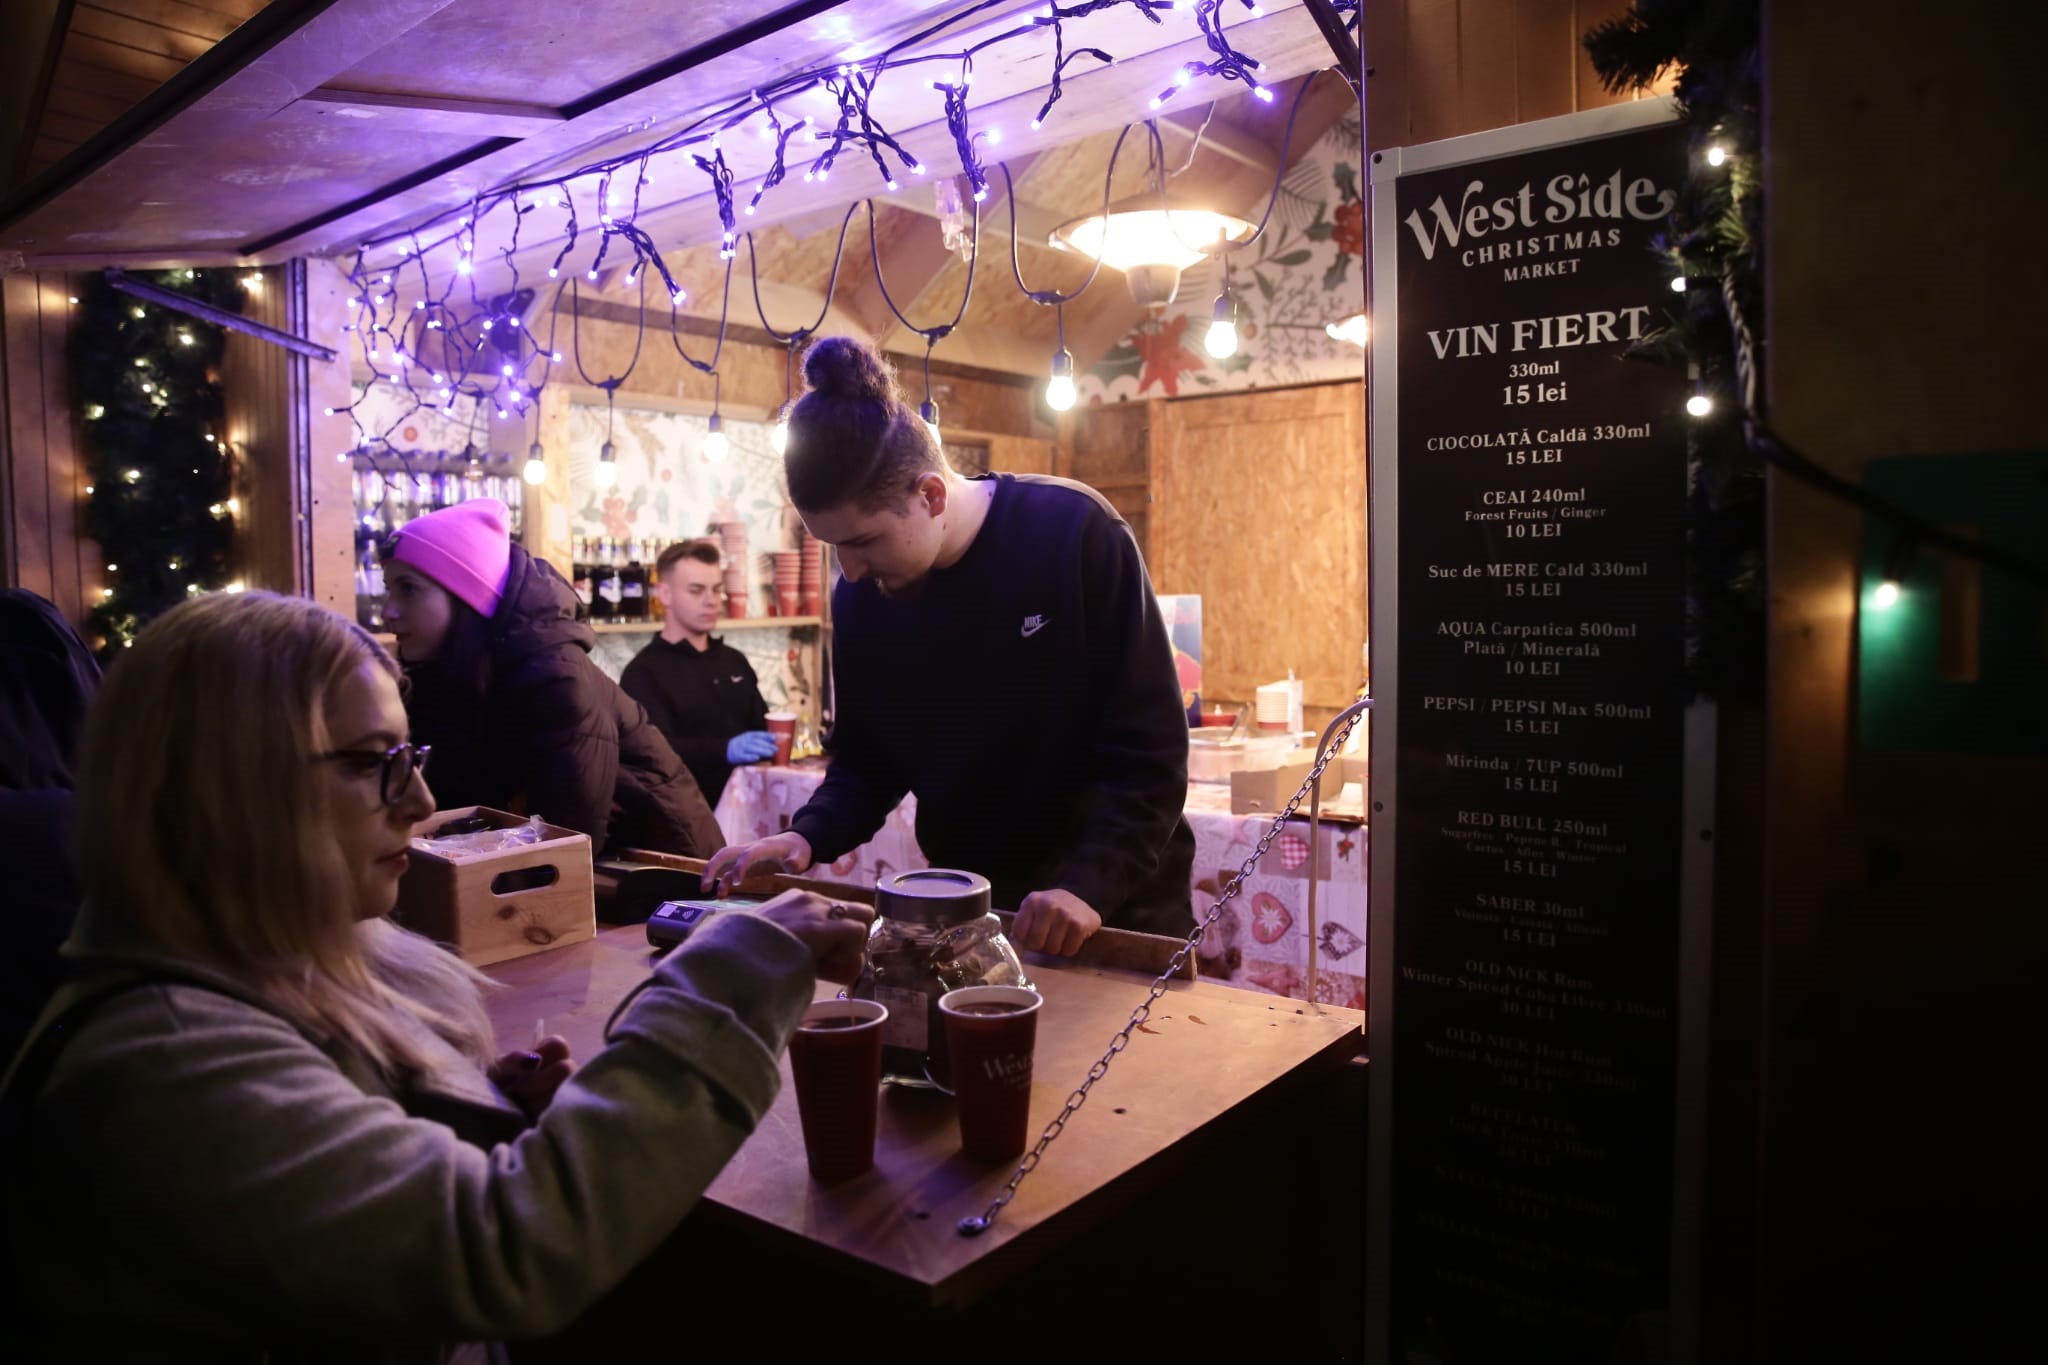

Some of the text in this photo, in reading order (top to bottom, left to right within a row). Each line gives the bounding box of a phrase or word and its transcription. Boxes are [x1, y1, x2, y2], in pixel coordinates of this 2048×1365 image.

[1405, 180, 1539, 261] West
[1462, 229, 1621, 267] CHRISTMAS
[1504, 258, 1581, 282] MARKET
[1427, 306, 1650, 360] VIN FIERT
[1509, 361, 1560, 377] 330ml
[1503, 382, 1567, 405] 15 lei
[1427, 423, 1651, 451] CIOCOLATĂ Caldă 330ml
[1506, 449, 1563, 466] 15 LEI
[1483, 488, 1585, 505] CEAI 240ml
[1465, 510, 1504, 520] Forest
[1509, 509, 1548, 520] Fruits
[1560, 507, 1606, 520] Ginger
[1505, 524, 1561, 538] 10 LEI
[1428, 562, 1648, 578] Suc de MERE Cald 330ml
[1506, 583, 1560, 596] 15 LEI
[1024, 614, 1042, 628] NIKE
[1437, 621, 1637, 639] AQUA Carpatica 500ml
[1464, 640, 1504, 655] Plată
[1522, 641, 1600, 657] Minerală
[1504, 661, 1560, 676] 10 LEI
[1424, 697, 1475, 711] PEPSI
[1491, 698, 1546, 714] PEPSI
[1552, 701, 1588, 716] Max
[1594, 704, 1652, 719] 500ml
[1504, 719, 1560, 734] 15 LEI
[1445, 754, 1509, 771] Mirinda
[1526, 759, 1561, 774] 7UP
[1568, 761, 1623, 778] 500ml
[1504, 776, 1558, 793] 15 LEI
[1458, 810, 1608, 838] RED BULL 250ml
[1504, 860, 1558, 878] 15 LEI
[1476, 893, 1584, 919] SABER 30ml
[1504, 929, 1556, 948] 15 LEI
[1402, 966, 1452, 988] Winter
[1466, 960, 1500, 976] OLD
[1505, 964, 1549, 984] NICK
